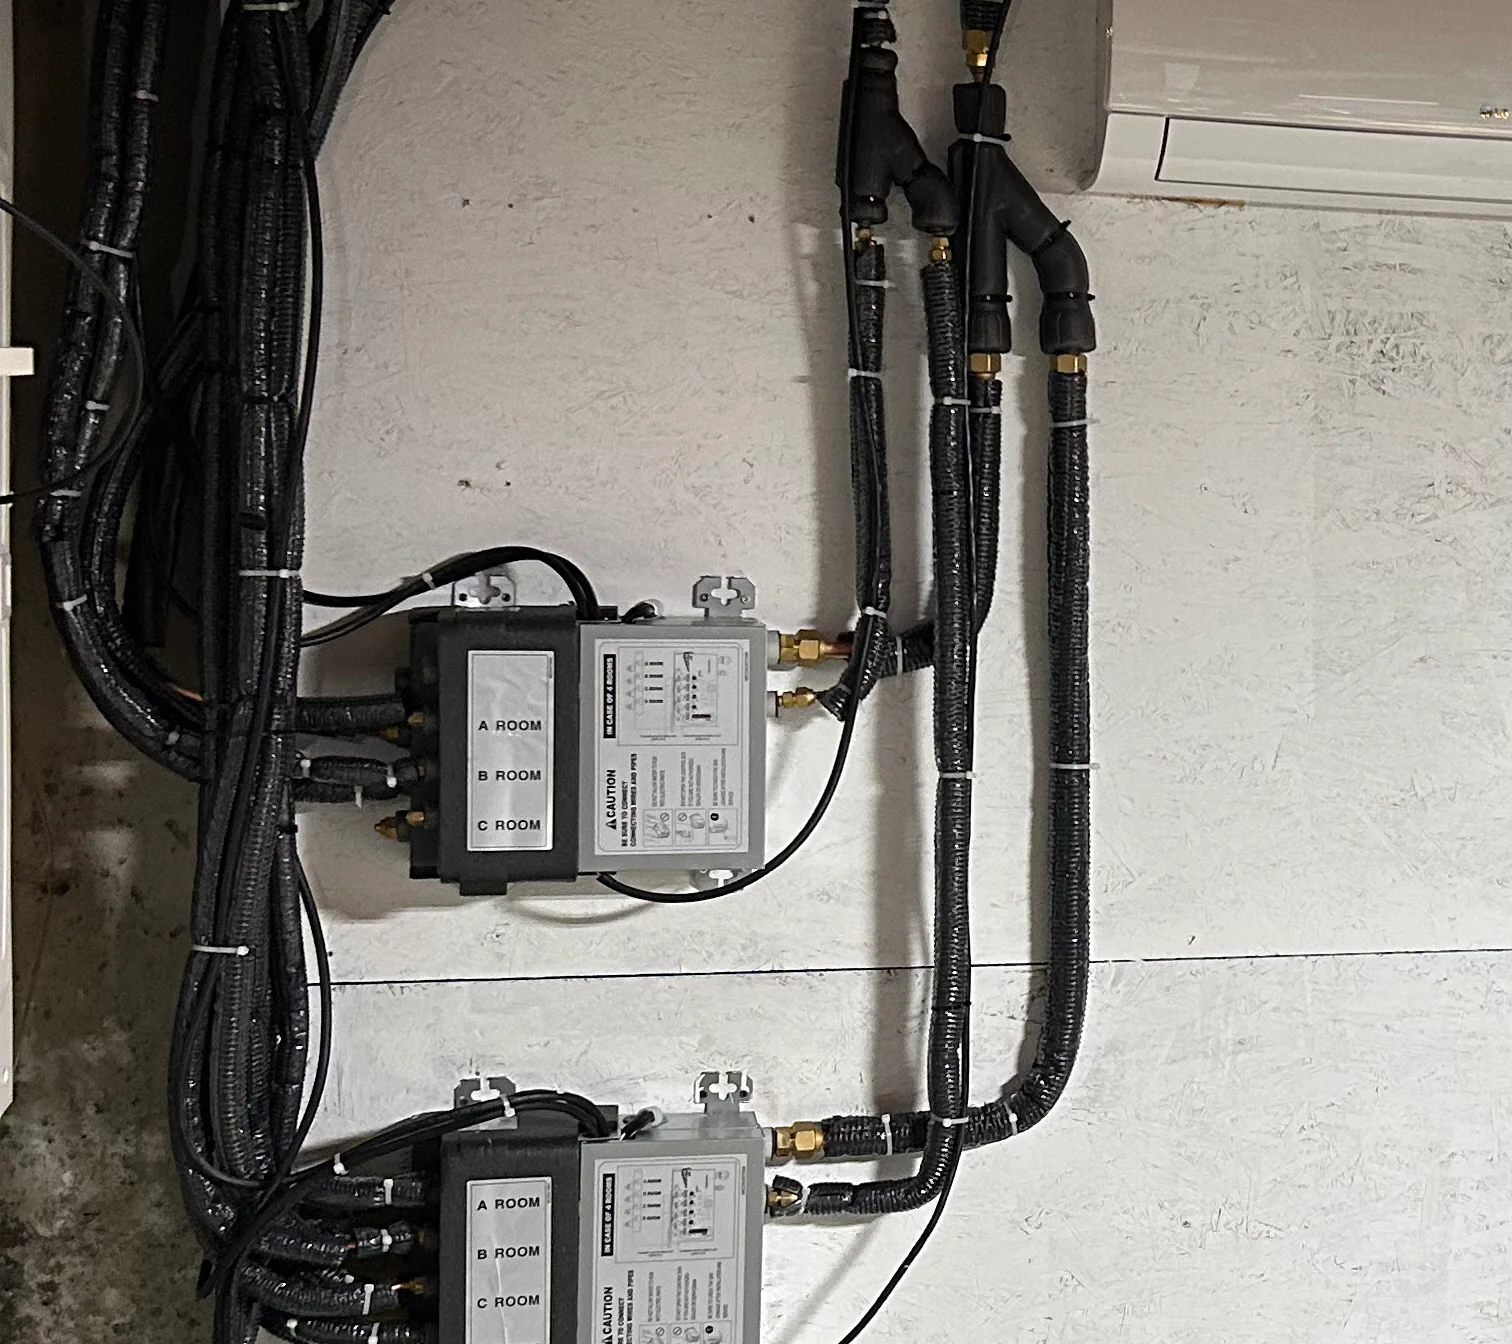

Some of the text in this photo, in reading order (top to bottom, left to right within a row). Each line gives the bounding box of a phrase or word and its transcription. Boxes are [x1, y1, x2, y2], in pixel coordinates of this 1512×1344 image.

[478, 719, 542, 732] A ROOM
[478, 769, 541, 781] B ROOM
[606, 769, 616, 819] CAUTION
[478, 819, 541, 831] C ROOM
[477, 1197, 540, 1210] A ROOM
[477, 1246, 540, 1260] B ROOM
[477, 1295, 540, 1308] C ROOM
[602, 1286, 613, 1335] CAUTION
